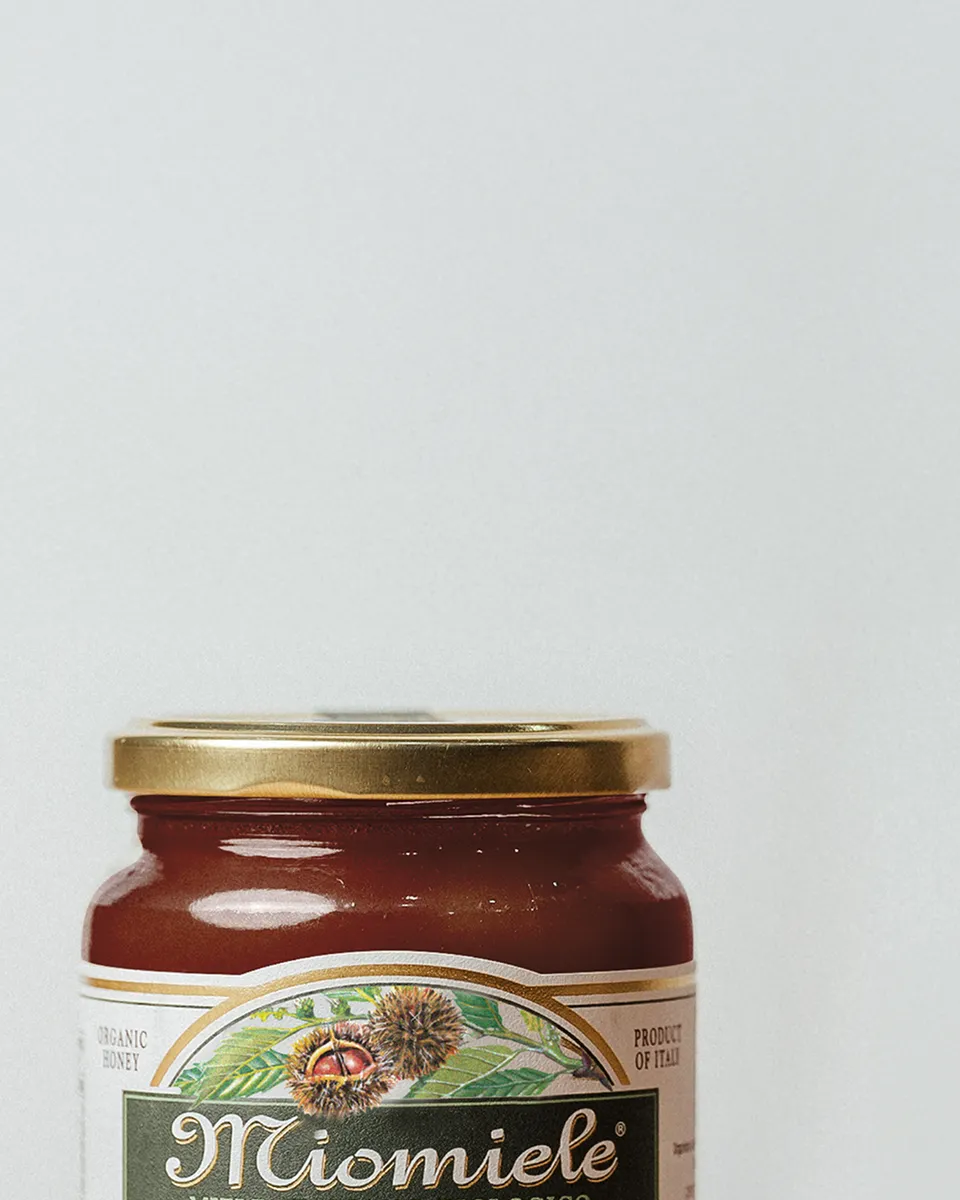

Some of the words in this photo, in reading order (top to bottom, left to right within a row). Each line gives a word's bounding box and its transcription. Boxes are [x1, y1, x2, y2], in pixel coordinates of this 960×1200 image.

[98, 1026, 148, 1049] ORGANIC
[634, 1024, 682, 1048] PRODUCT
[102, 1049, 140, 1072] HONEY
[635, 1051, 651, 1071] OF
